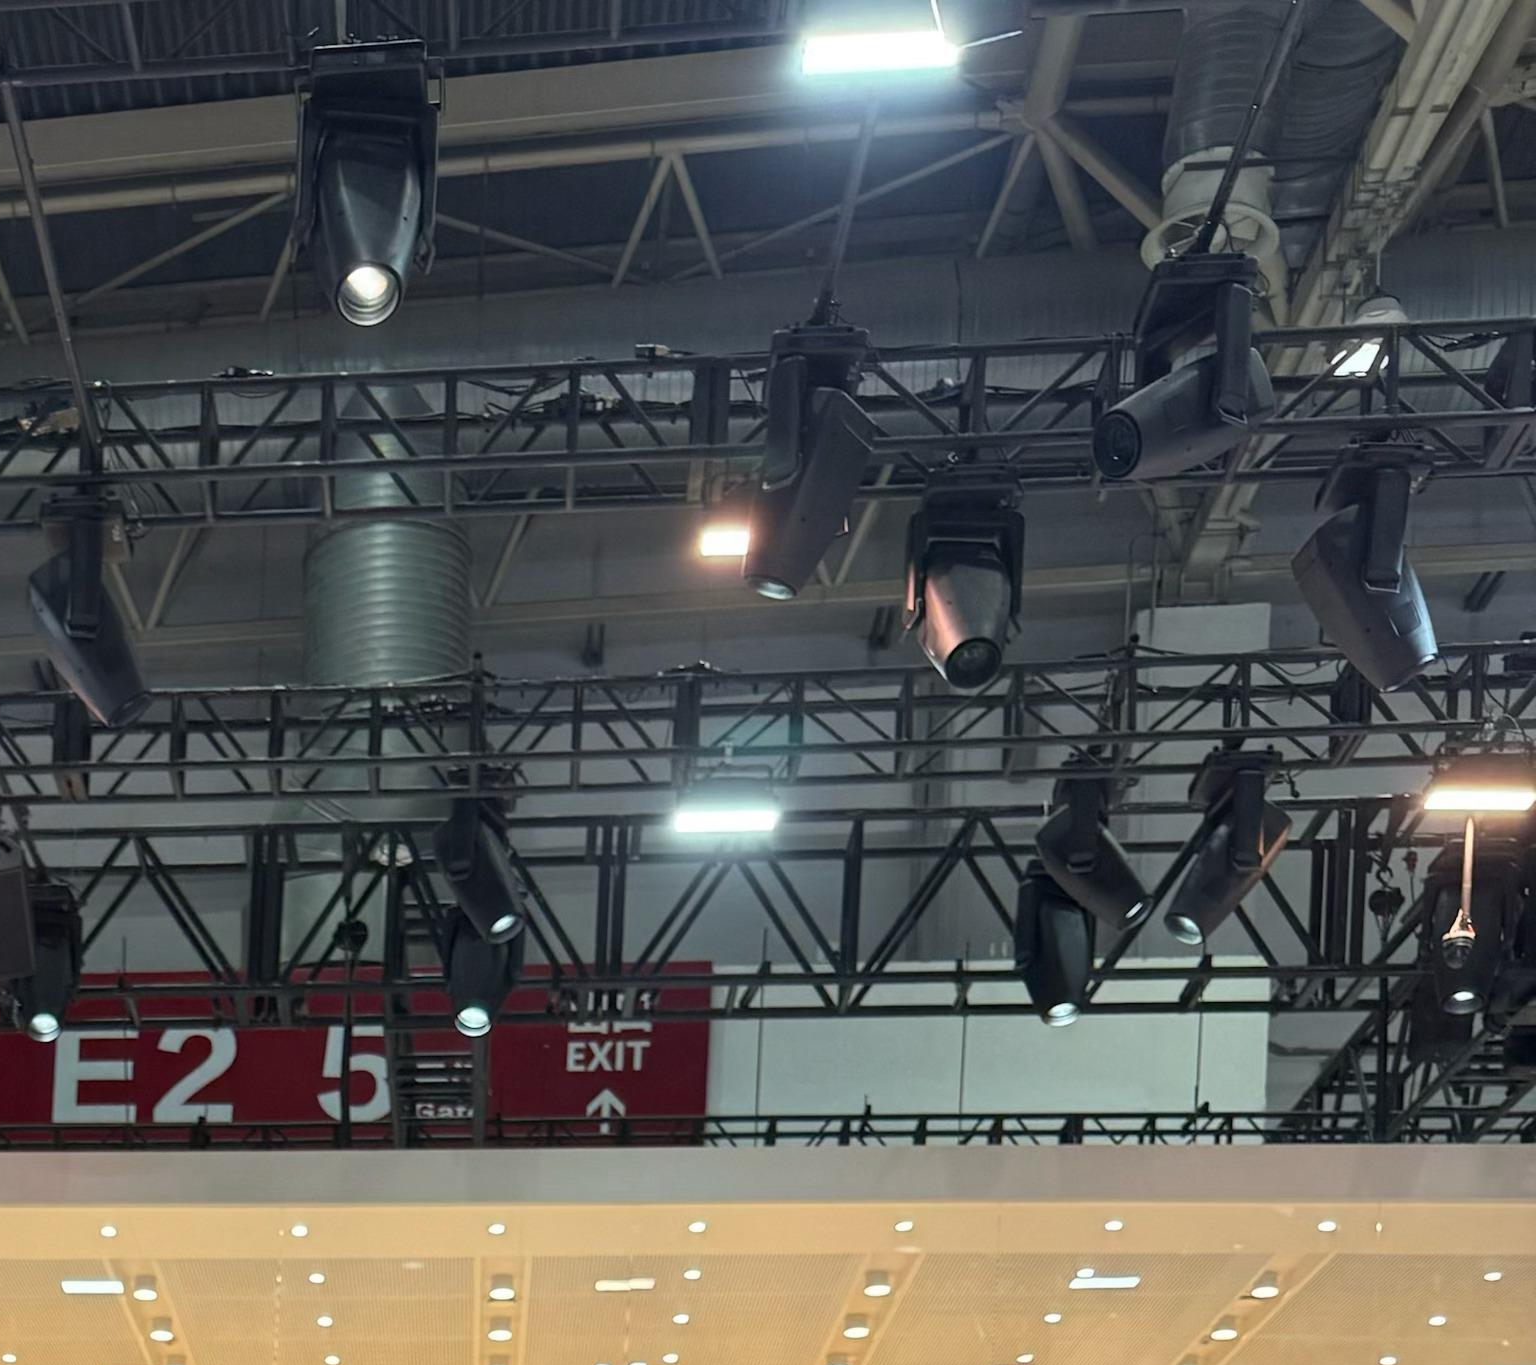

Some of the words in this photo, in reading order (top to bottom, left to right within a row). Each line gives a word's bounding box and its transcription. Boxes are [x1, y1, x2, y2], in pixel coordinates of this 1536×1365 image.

[52, 1027, 238, 1124] E2
[317, 1025, 392, 1123] 5
[566, 1040, 652, 1072] EXIT
